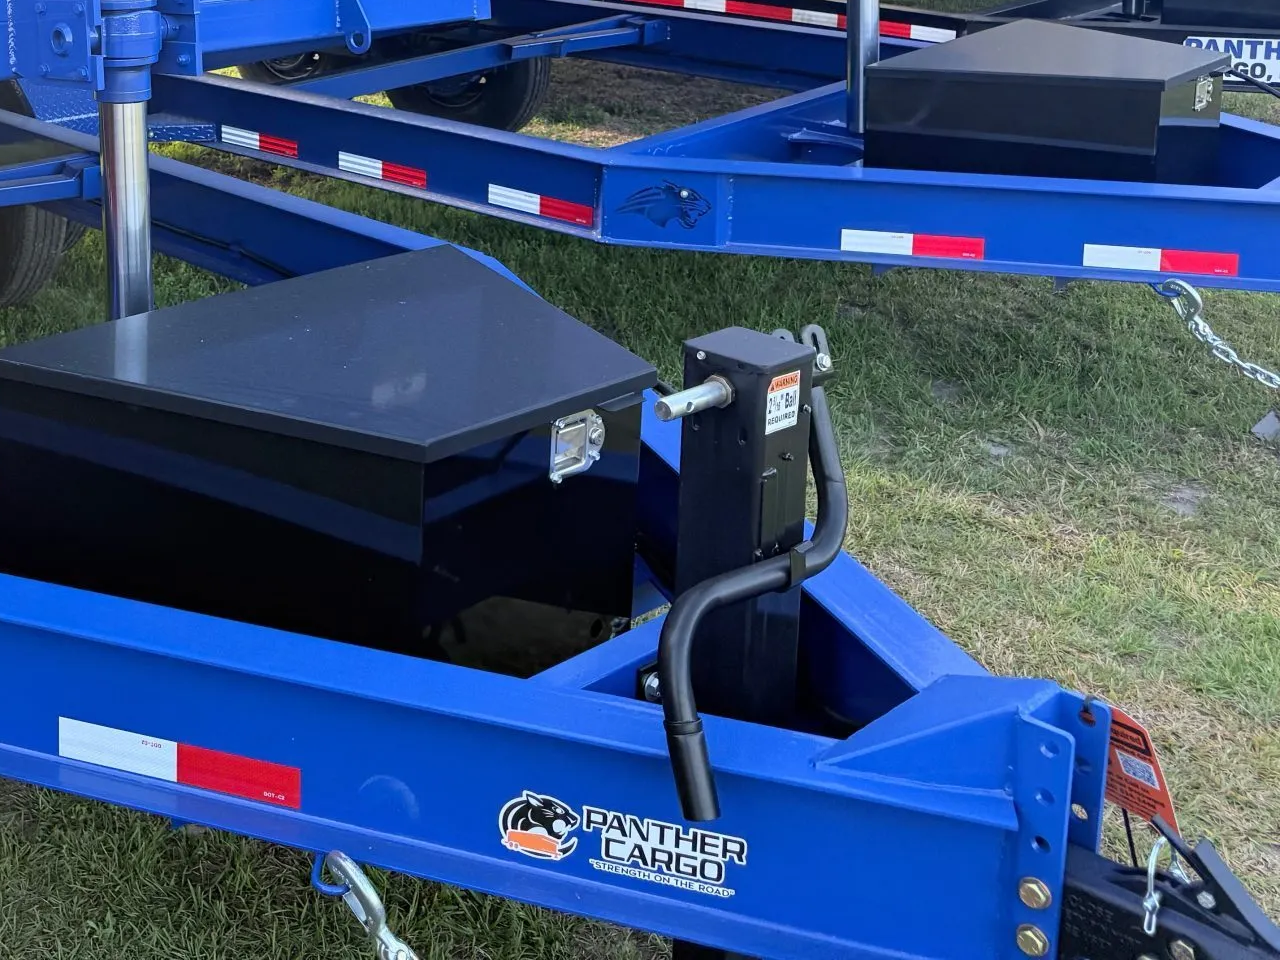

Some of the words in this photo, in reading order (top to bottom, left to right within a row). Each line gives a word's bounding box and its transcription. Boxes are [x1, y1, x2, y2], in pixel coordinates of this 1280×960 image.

[784, 389, 797, 409] Ball
[767, 410, 796, 427] REQUIRED
[263, 791, 285, 801] DOT-C2
[584, 807, 746, 863] PANTHER
[604, 836, 723, 883] CARGO
[591, 860, 651, 880] "STRENGTH
[654, 874, 671, 885] ON
[674, 878, 695, 890] THE
[698, 884, 735, 898] ROAD"
